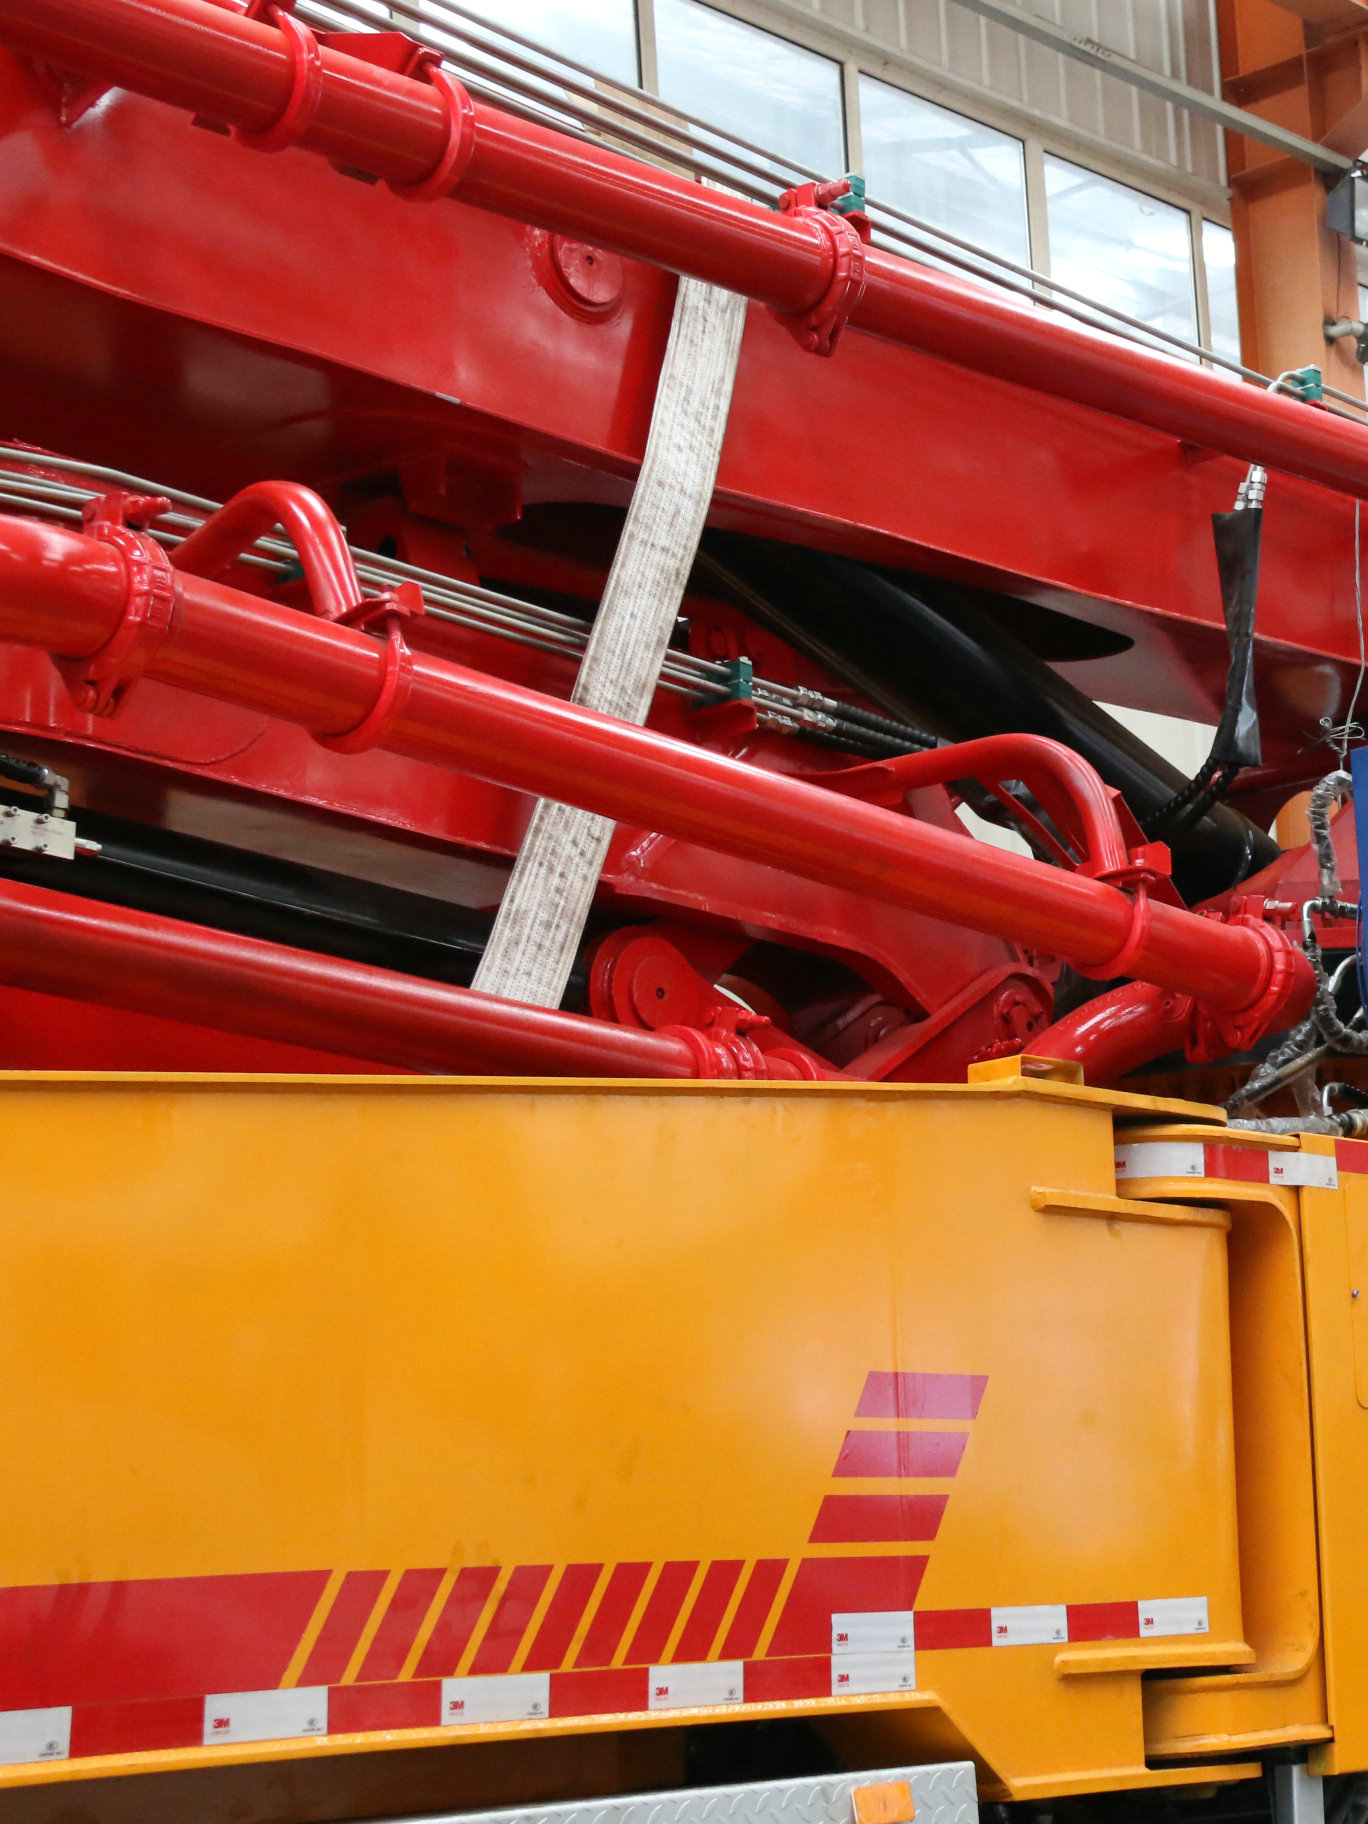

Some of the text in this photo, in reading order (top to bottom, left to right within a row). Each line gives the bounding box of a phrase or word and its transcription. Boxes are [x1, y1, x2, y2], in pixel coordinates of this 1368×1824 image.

[1273, 1167, 1285, 1175] 3M
[1144, 1617, 1154, 1625] 3M
[997, 1626, 1008, 1634] 3M
[837, 1633, 848, 1642] 3M
[837, 1674, 849, 1683] 3M
[655, 1687, 669, 1697] 3M
[449, 1701, 465, 1711] 3M
[213, 1718, 231, 1729] 3M
